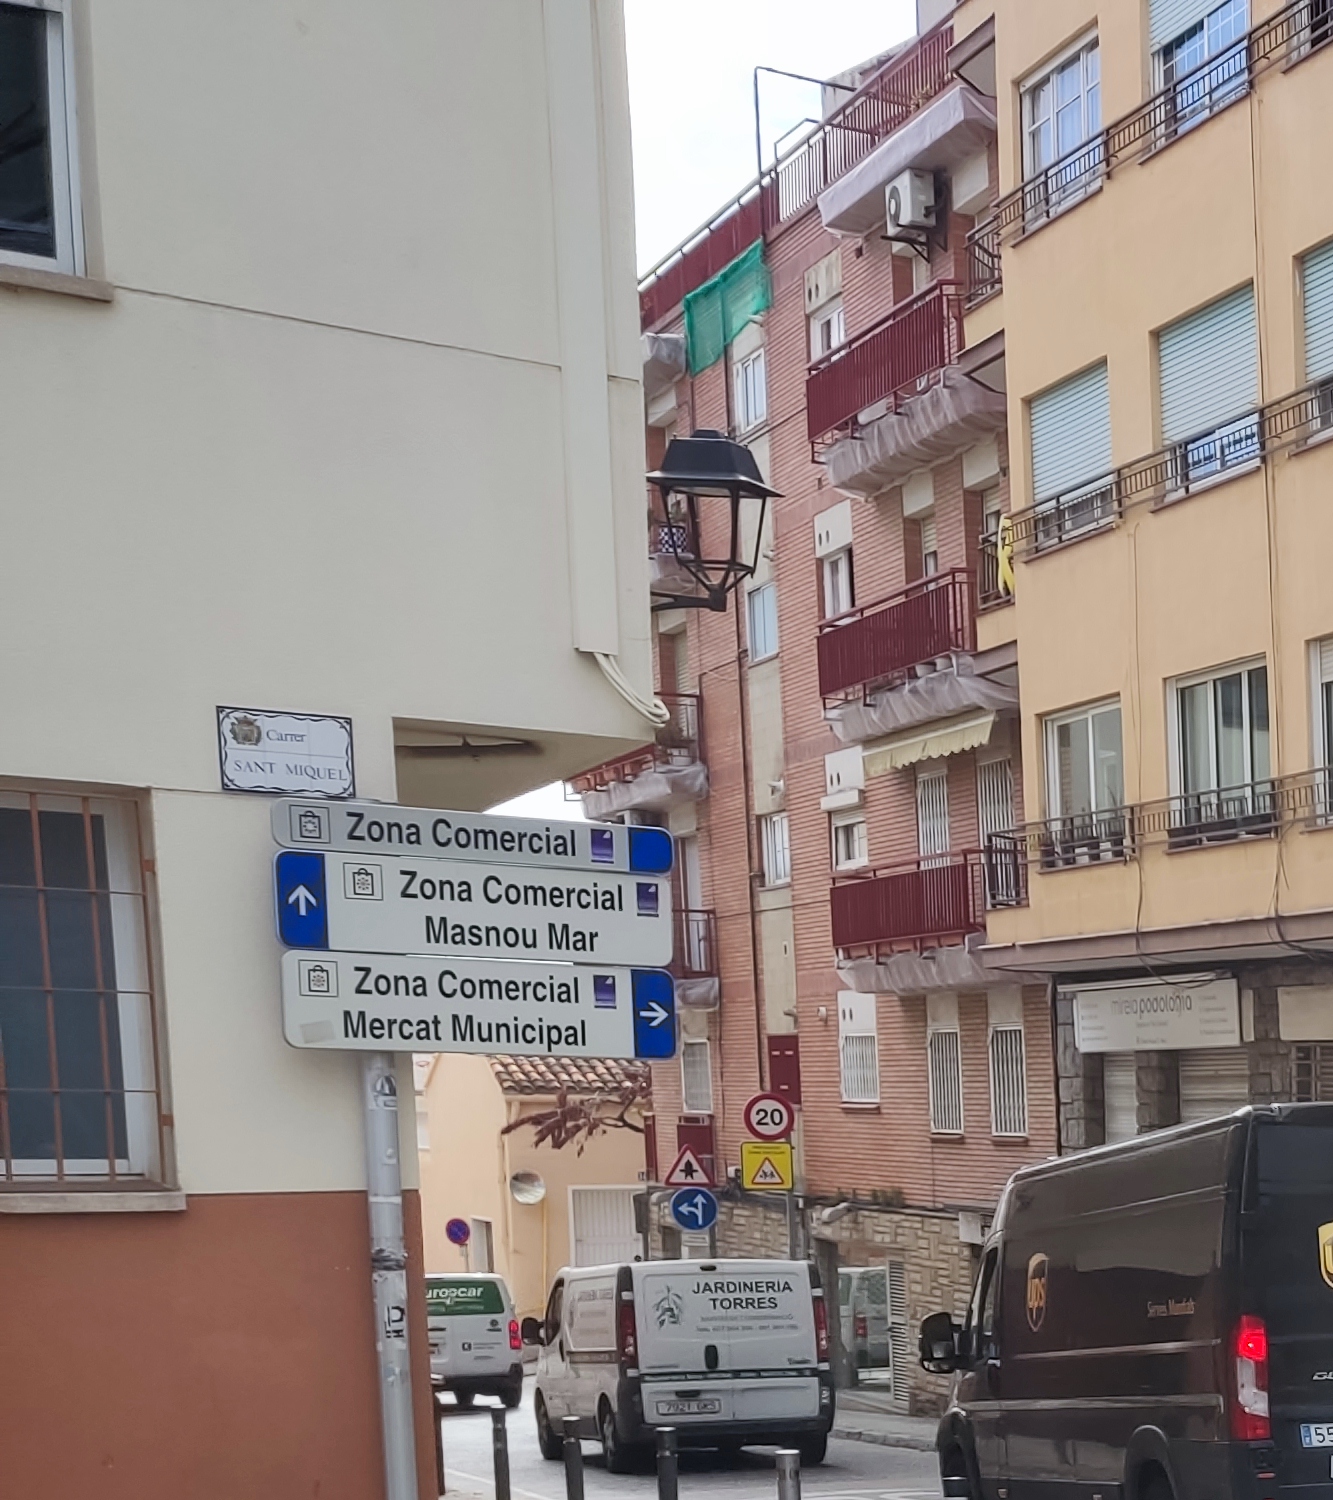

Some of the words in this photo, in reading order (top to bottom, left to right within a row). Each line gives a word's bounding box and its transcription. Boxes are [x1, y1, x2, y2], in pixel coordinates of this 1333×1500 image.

[266, 729, 307, 743] Carrer
[233, 760, 276, 774] SANT
[285, 763, 348, 781] MIQUEL
[345, 811, 422, 846] Zona
[431, 818, 577, 857] Comercial
[399, 870, 473, 903] Zona
[482, 875, 624, 912] Comercial
[425, 916, 539, 950] Masnou
[548, 922, 599, 952] Mar
[354, 966, 428, 998] Zona
[437, 969, 579, 1005] Comercial
[343, 1011, 440, 1042] Mercat
[451, 1014, 587, 1053] Municipal
[755, 1108, 784, 1126] 20
[692, 1278, 793, 1295] JARDINERÍA
[709, 1297, 778, 1311] TORRES
[1028, 1277, 1045, 1320] ups
